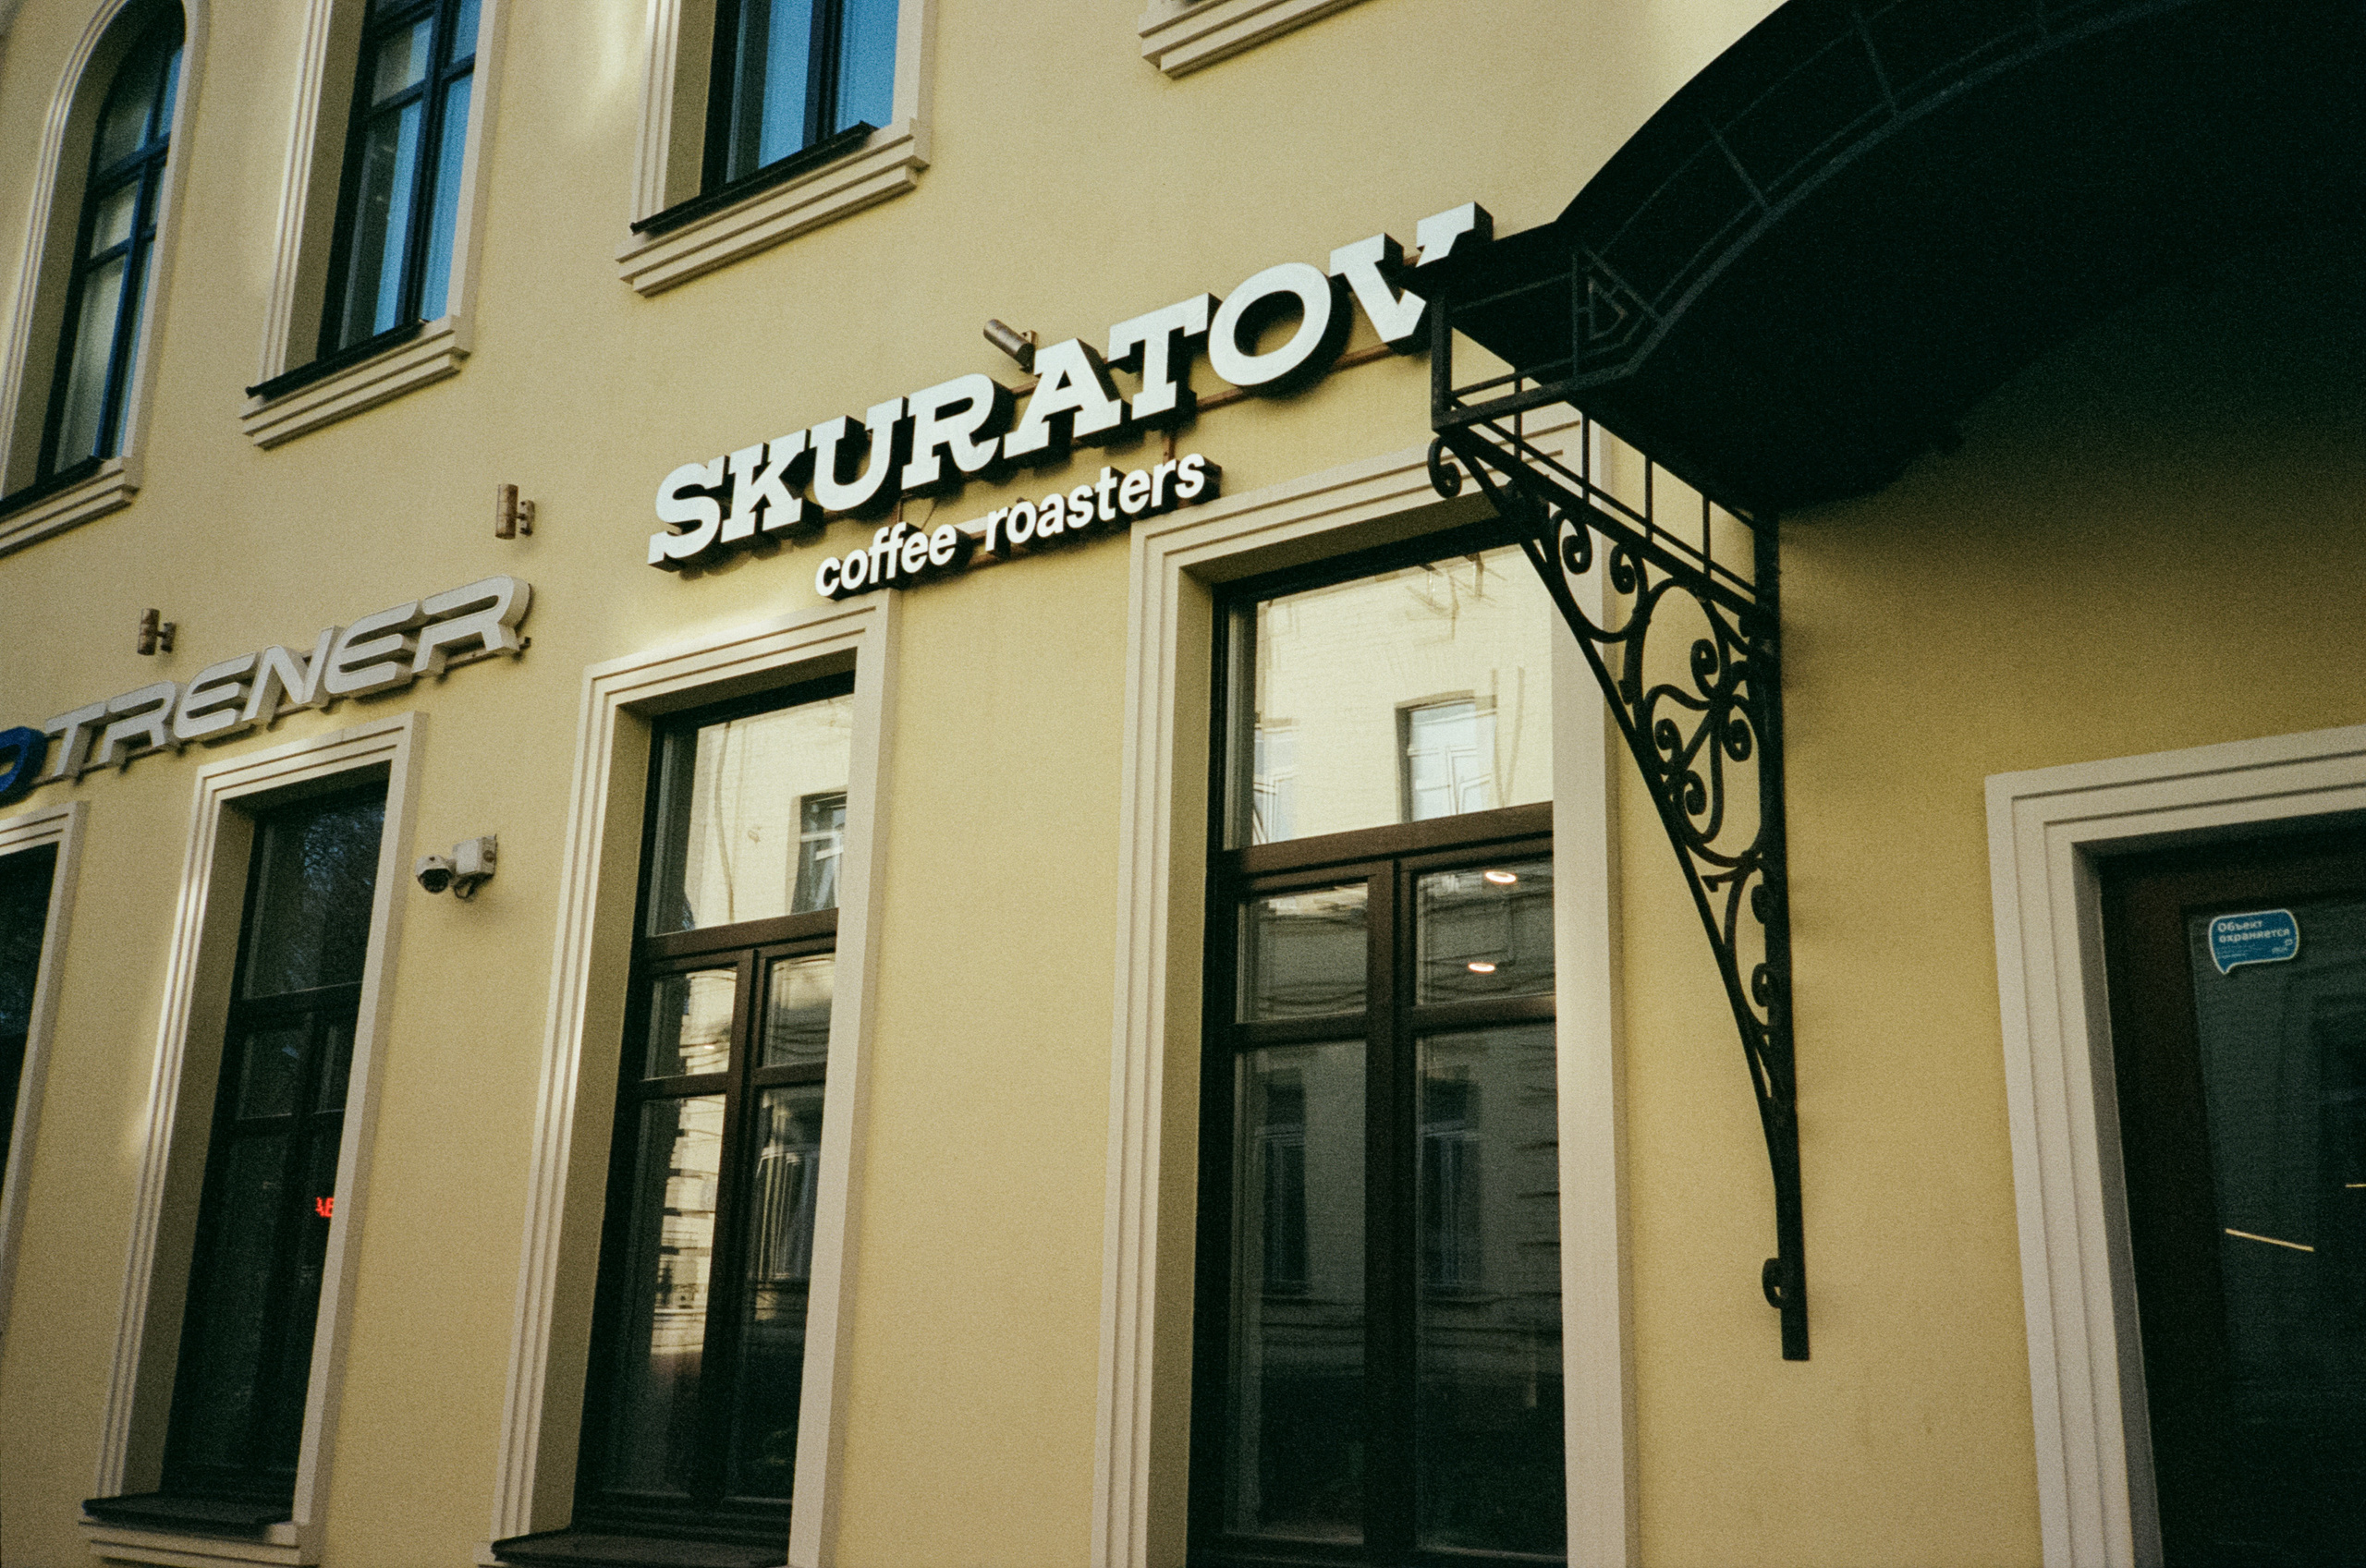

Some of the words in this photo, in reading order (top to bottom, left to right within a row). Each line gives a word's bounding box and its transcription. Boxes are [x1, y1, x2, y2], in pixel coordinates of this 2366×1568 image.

[648, 201, 1477, 565] SKURATOV
[814, 522, 957, 598] coffee
[984, 453, 1207, 553] roasters
[2217, 920, 2262, 932] Объект
[2218, 928, 2290, 943] охраняется
